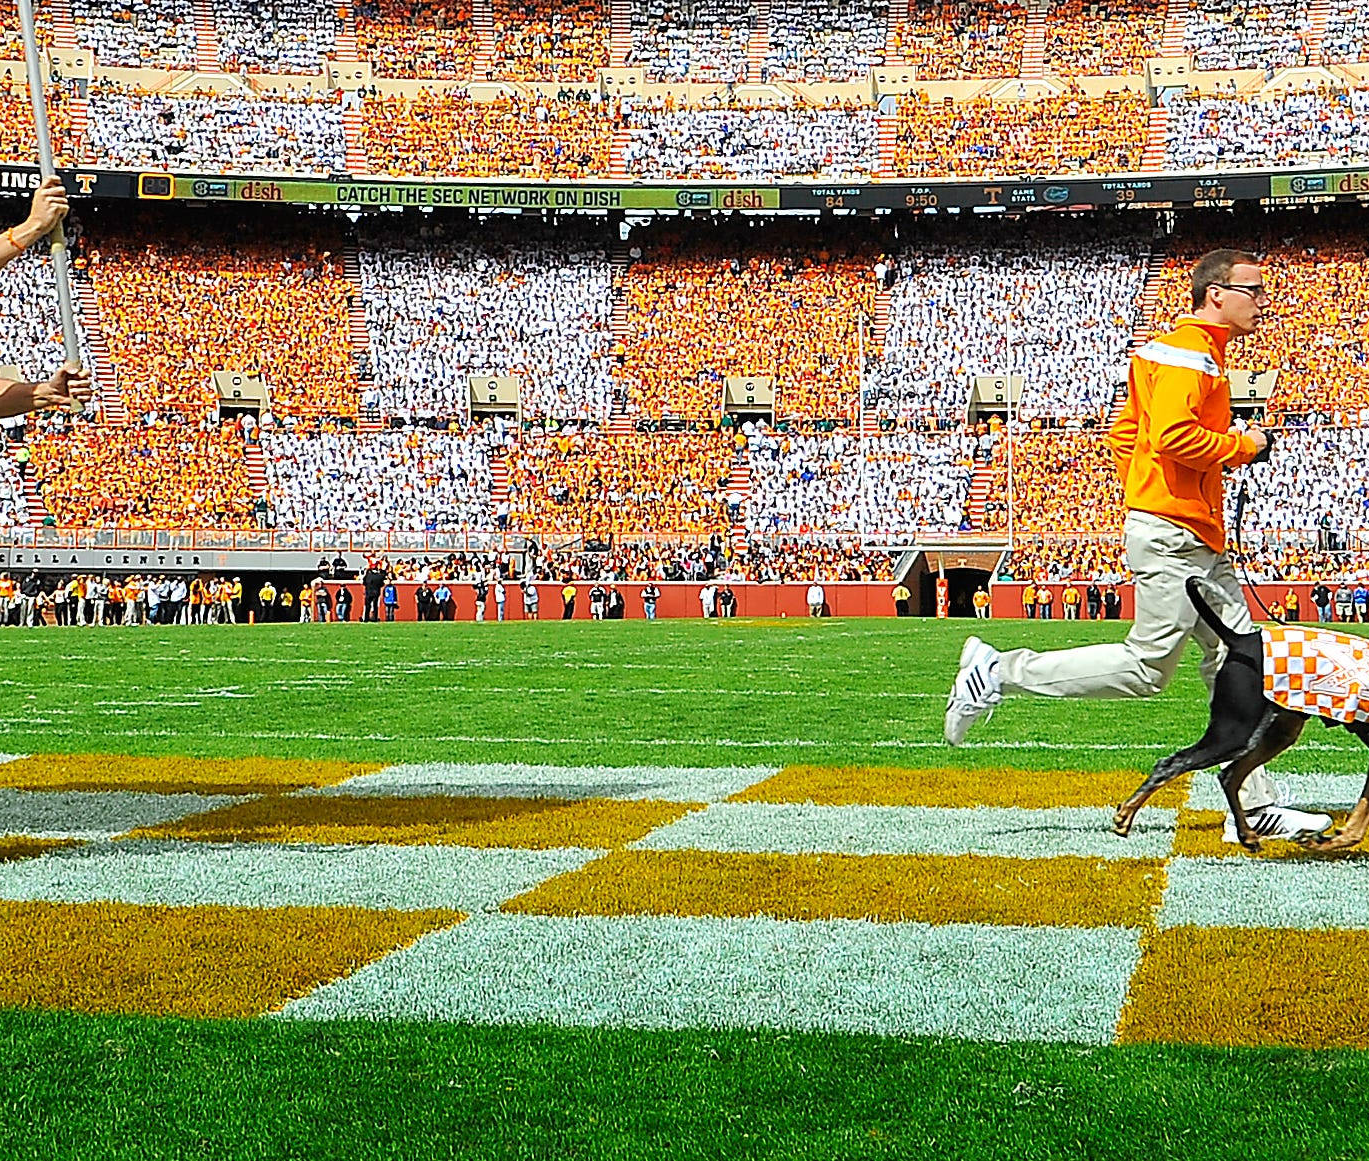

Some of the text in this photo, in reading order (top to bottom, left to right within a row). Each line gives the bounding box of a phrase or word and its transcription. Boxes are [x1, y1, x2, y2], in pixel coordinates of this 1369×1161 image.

[75, 173, 97, 194] T
[241, 181, 283, 200] dish
[336, 186, 621, 207] CATCH THE SEC NETWORK ON DISH
[723, 190, 763, 208] dish
[983, 187, 1003, 205] T
[1116, 189, 1136, 201] 39
[1194, 186, 1227, 199] 6:47
[825, 196, 844, 208] 84
[905, 195, 938, 206] 9:50
[105, 553, 201, 566] CENTER
